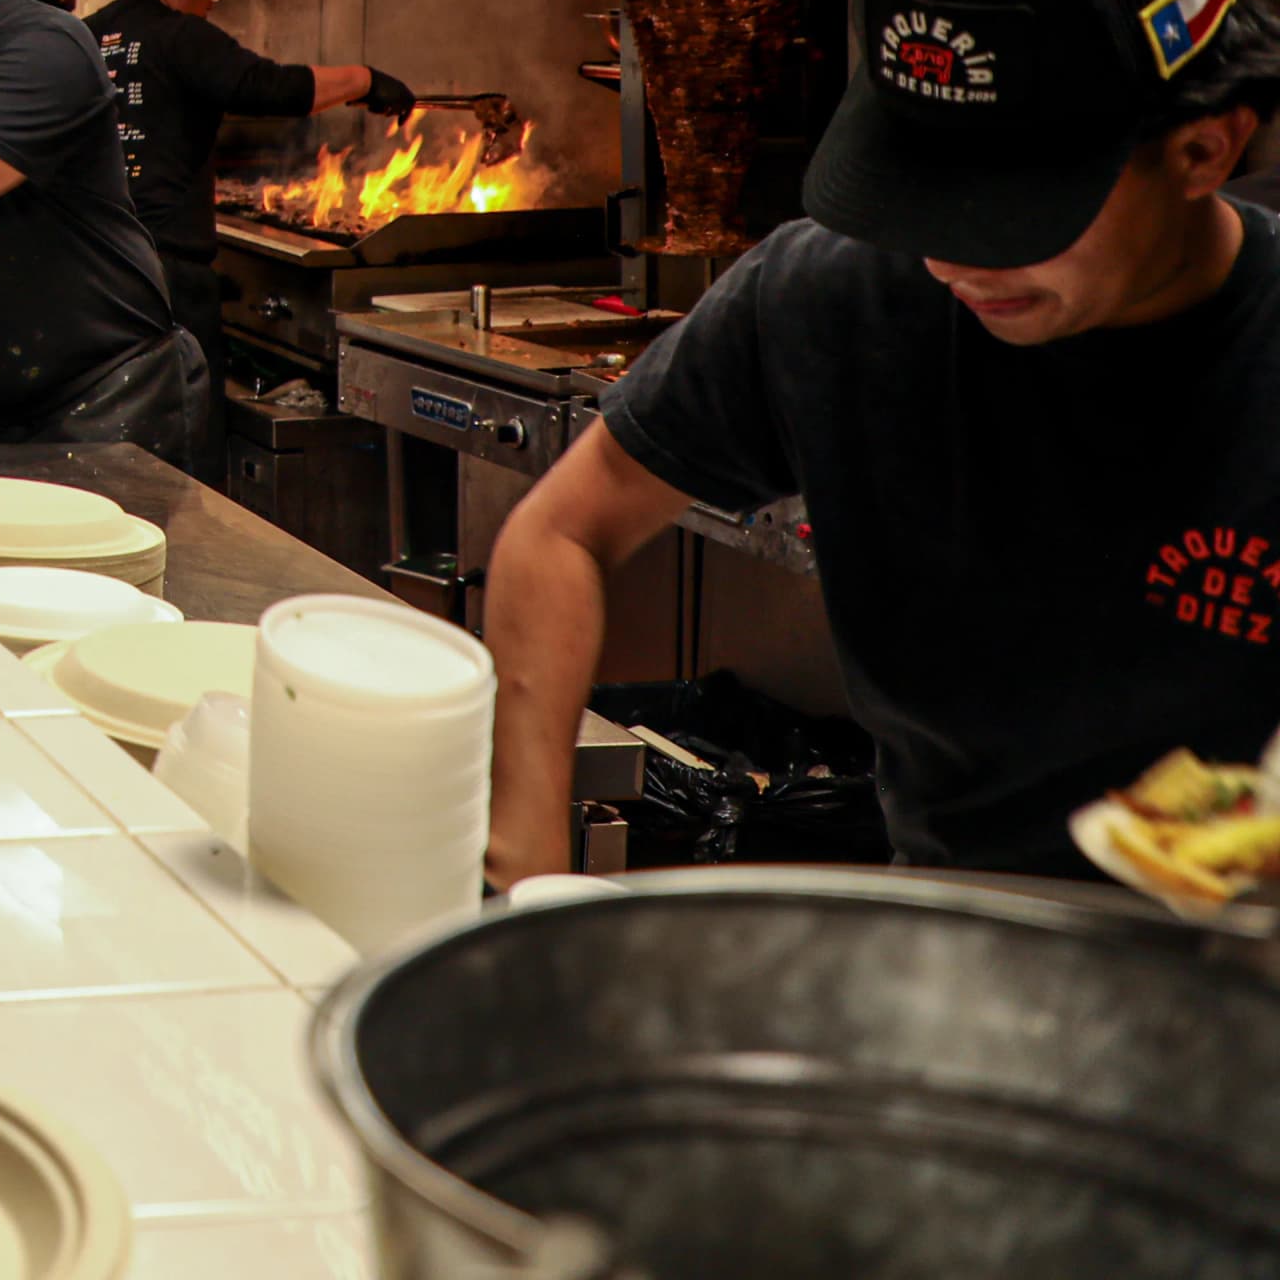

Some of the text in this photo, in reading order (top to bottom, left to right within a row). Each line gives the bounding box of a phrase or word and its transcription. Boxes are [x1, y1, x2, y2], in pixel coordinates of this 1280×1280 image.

[897, 72, 918, 92] DE
[921, 80, 966, 103] DIEZ
[1203, 566, 1255, 607] DE
[1176, 594, 1272, 644] DIEZ
